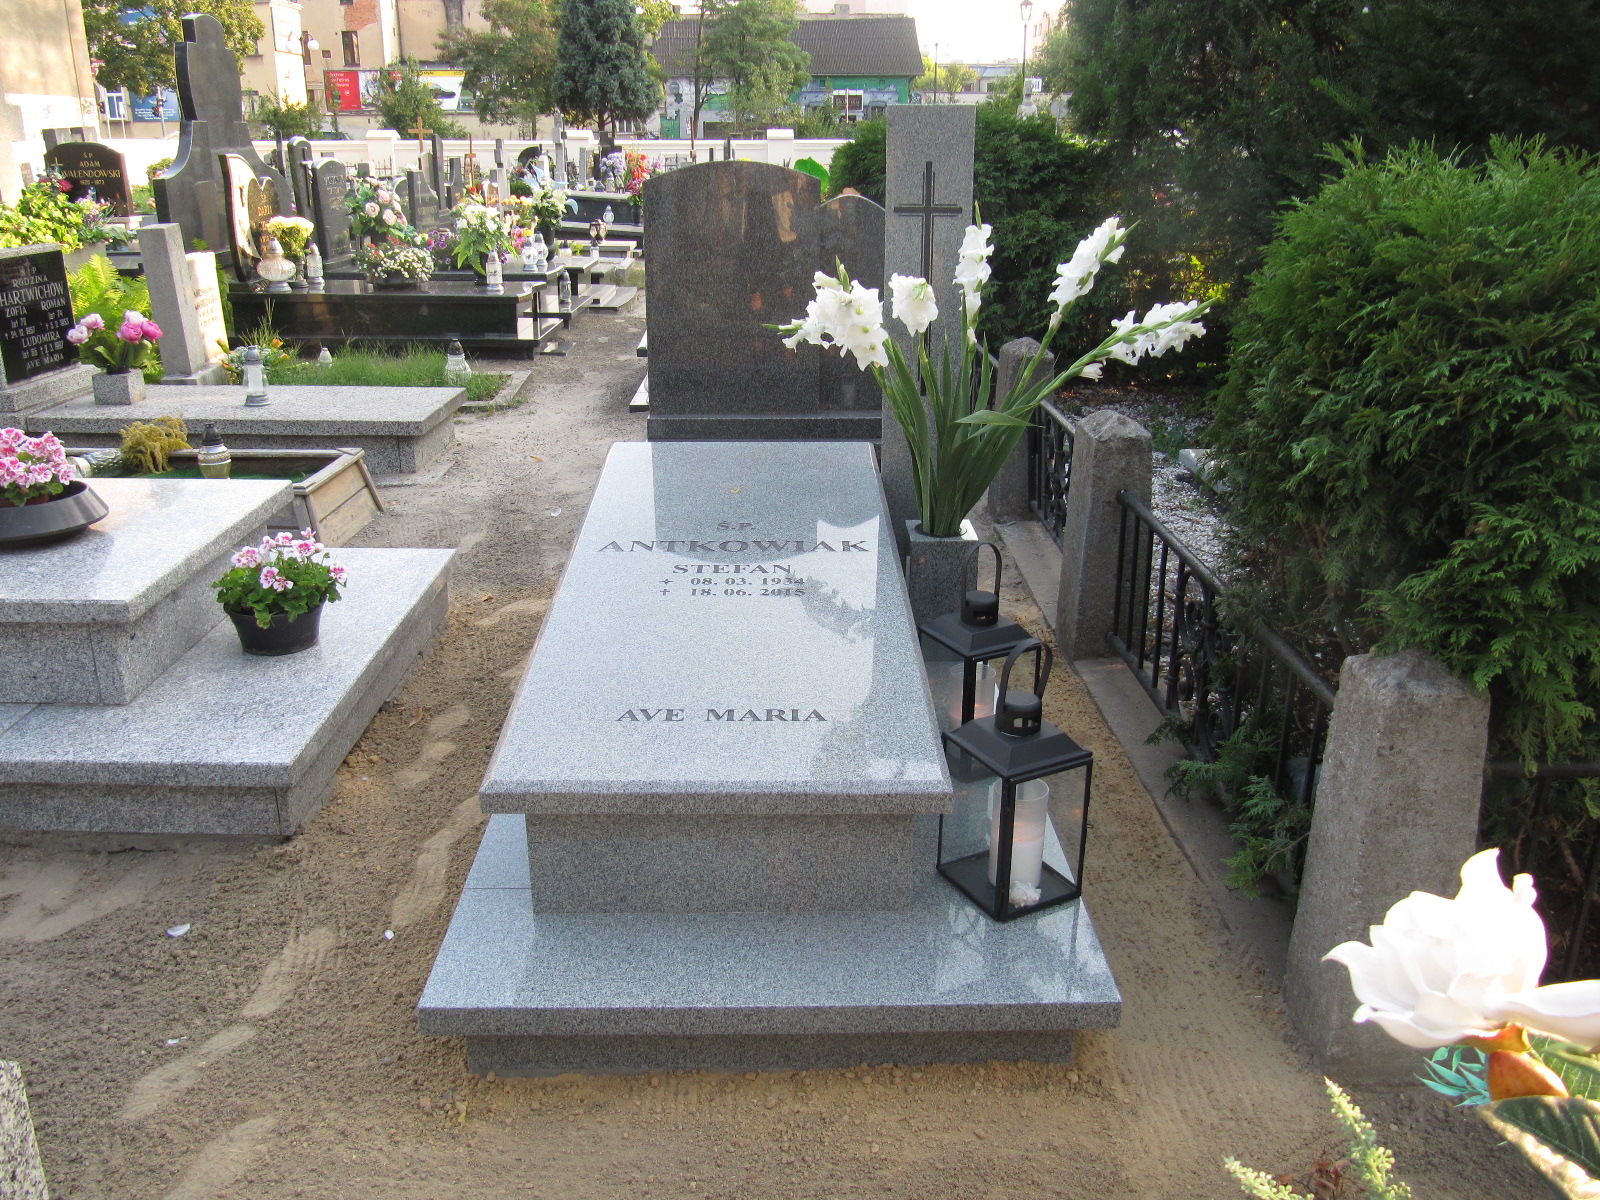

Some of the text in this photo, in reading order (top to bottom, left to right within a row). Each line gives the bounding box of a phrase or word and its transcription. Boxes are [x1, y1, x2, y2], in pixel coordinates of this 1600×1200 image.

[12, 275, 48, 288] RODZINA
[0, 281, 64, 307] HARTWICHÓW
[41, 297, 66, 311] ROMAN
[5, 305, 28, 318] ZOFIA
[21, 330, 61, 348] LUDOMIRA
[26, 353, 64, 369] AVE MARIA
[599, 540, 870, 553] ANTKOWIAK
[672, 564, 792, 574] STEFAN
[761, 577, 806, 586] 1934
[760, 588, 806, 597] 2015
[615, 708, 828, 722] AVE MARIA
